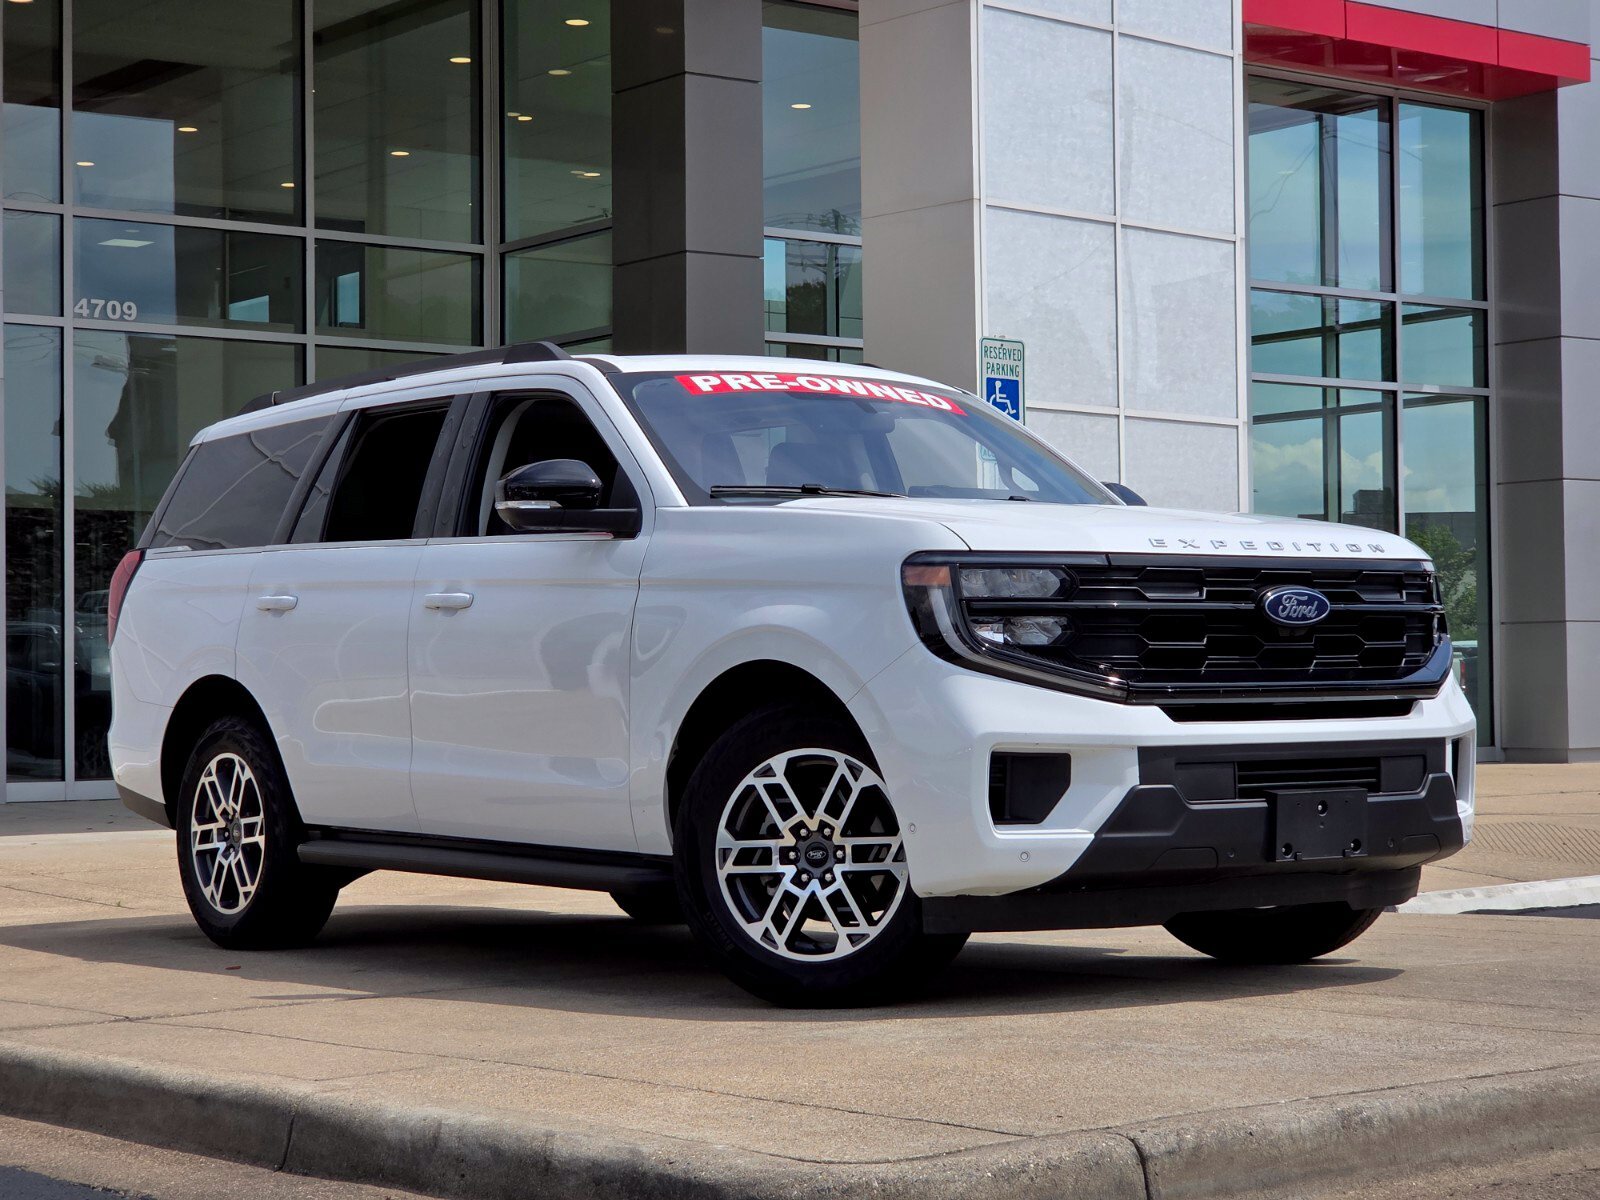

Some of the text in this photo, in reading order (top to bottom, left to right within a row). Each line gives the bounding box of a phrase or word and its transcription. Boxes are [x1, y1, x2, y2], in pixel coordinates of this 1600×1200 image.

[73, 298, 138, 321] 4709
[983, 345, 1022, 362] RESERVED
[986, 361, 1020, 378] PARKING
[689, 374, 953, 411] PRE-OWNED
[1148, 537, 1386, 553] EXPEDITION
[1278, 593, 1318, 618] Ford
